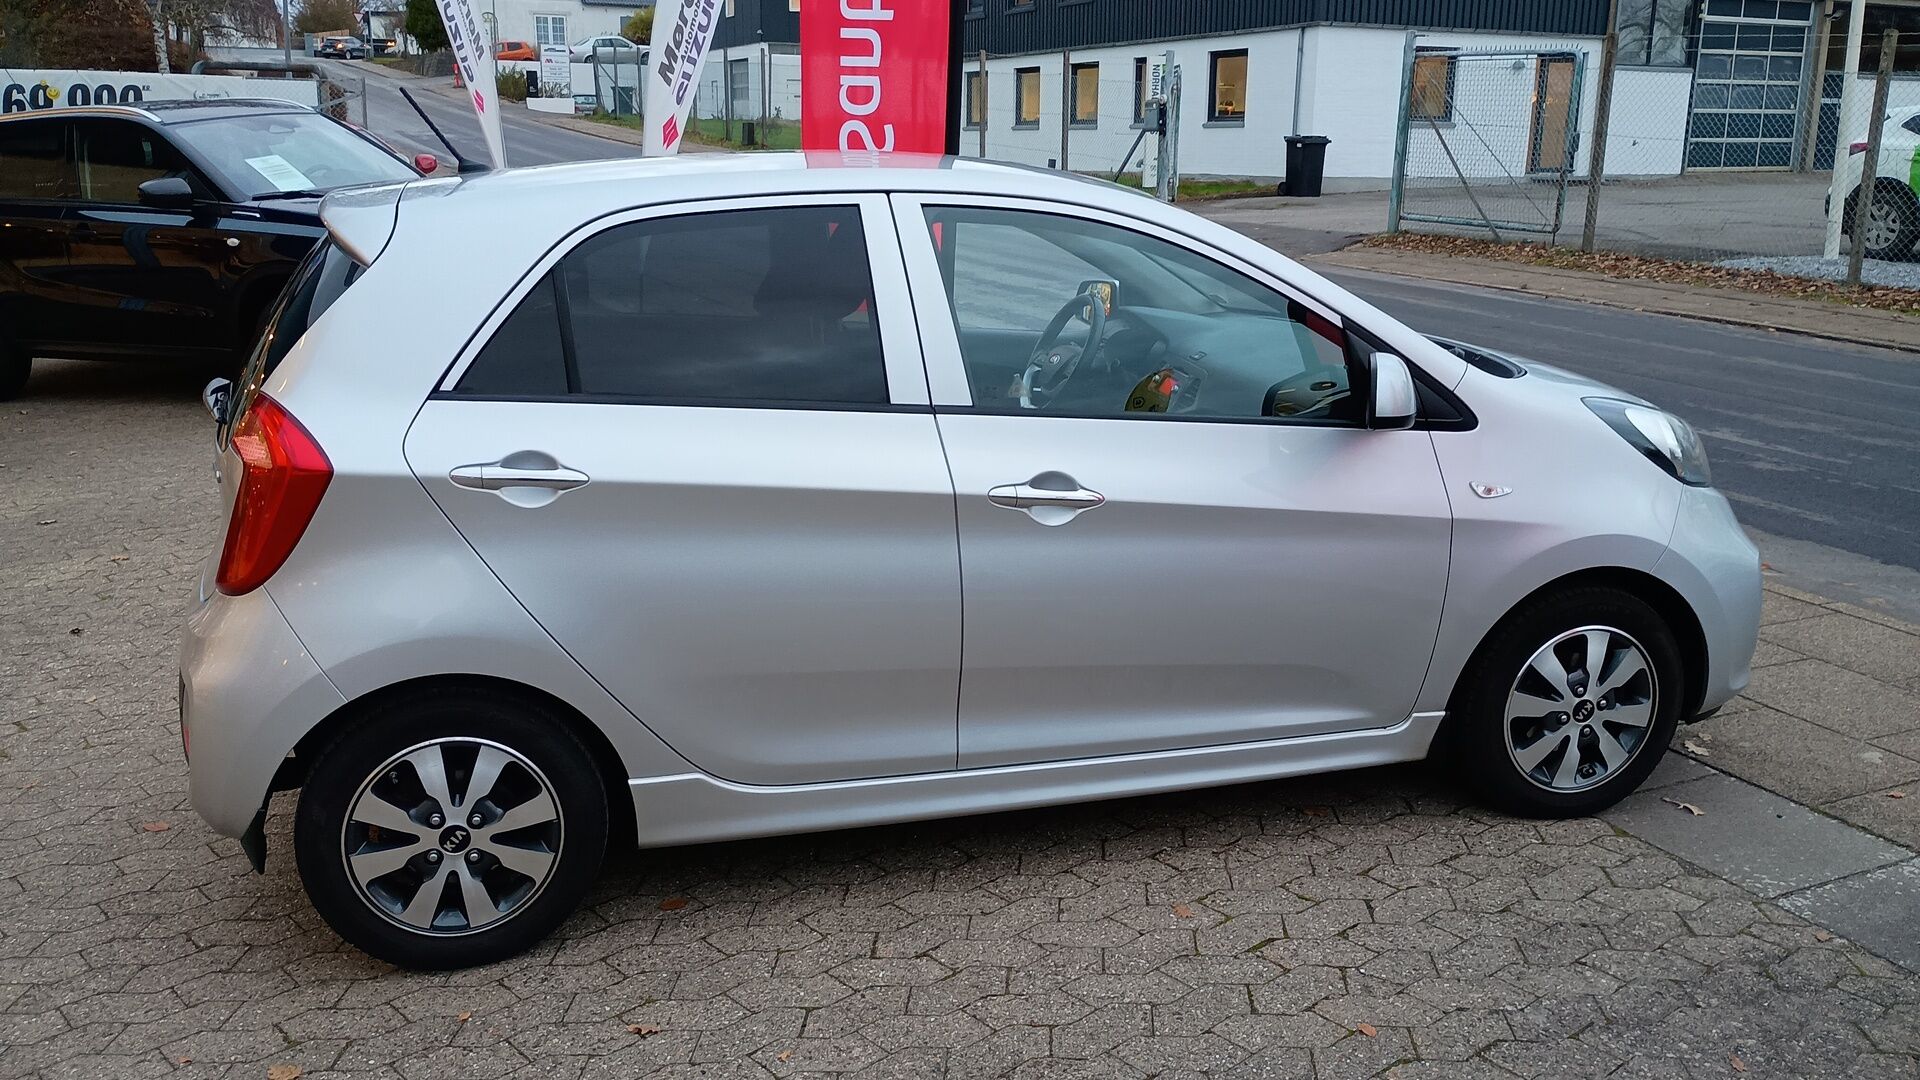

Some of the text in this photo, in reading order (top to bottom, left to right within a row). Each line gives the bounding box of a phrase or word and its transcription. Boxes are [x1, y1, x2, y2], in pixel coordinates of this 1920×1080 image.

[1152, 64, 1160, 100] NORHA
[1575, 701, 1593, 720] KIA
[443, 830, 467, 851] KIA
